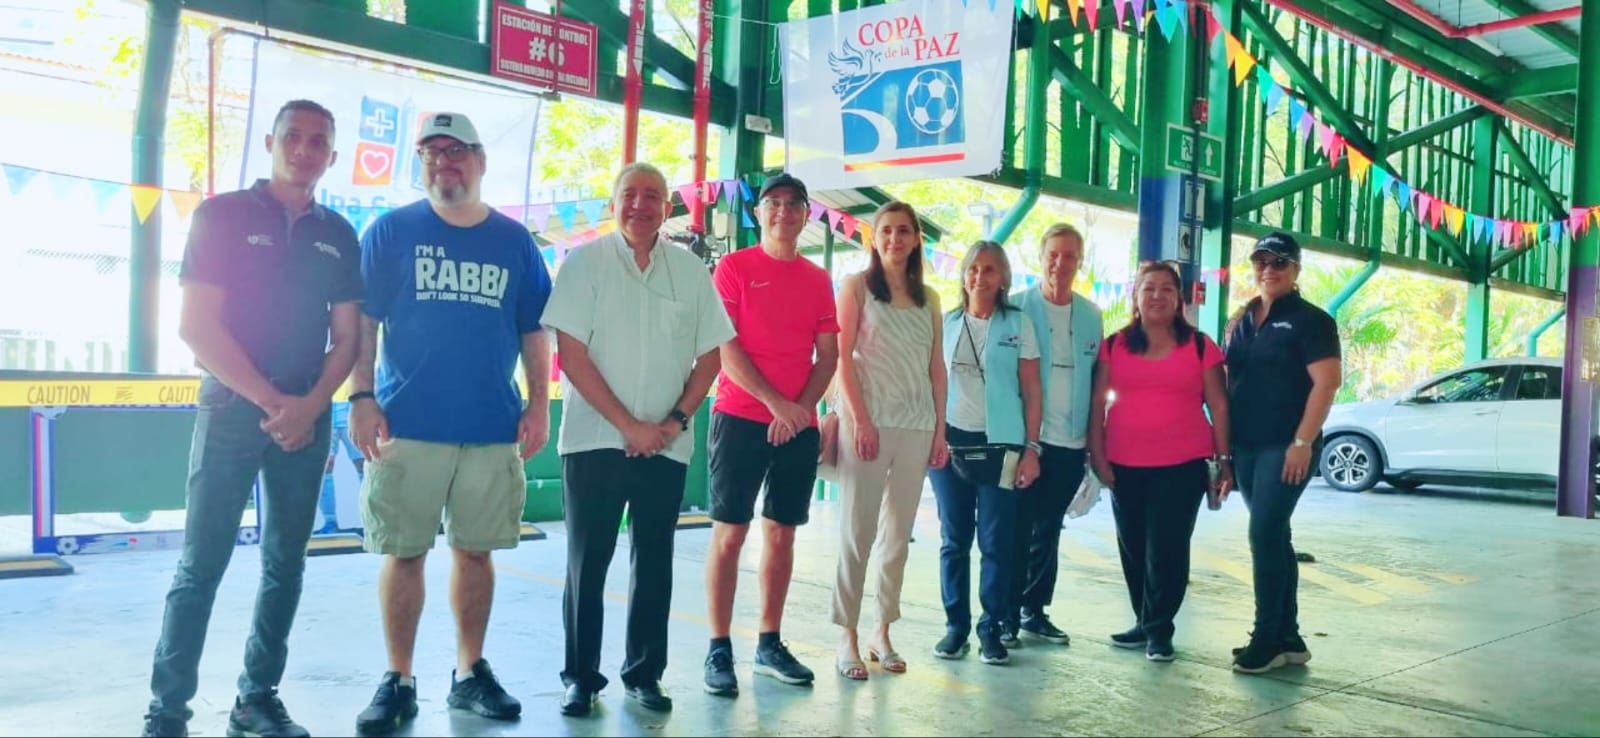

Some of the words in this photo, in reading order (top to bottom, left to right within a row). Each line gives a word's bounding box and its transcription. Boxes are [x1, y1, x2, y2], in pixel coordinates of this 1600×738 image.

[542, 24, 553, 37] DE
[554, 27, 588, 46] ONTROL
[858, 14, 925, 47] COPA
[528, 36, 565, 67] #6
[884, 48, 898, 60] de
[900, 47, 910, 57] la
[914, 32, 961, 61] PAZ
[415, 244, 433, 257] I'M
[436, 246, 446, 258] A
[415, 257, 509, 300] RABBI
[416, 291, 437, 300] DON'T
[438, 291, 458, 300] LOOK
[460, 293, 470, 302] SO
[27, 385, 91, 405] CAUTION
[158, 385, 197, 404] CAUTI
